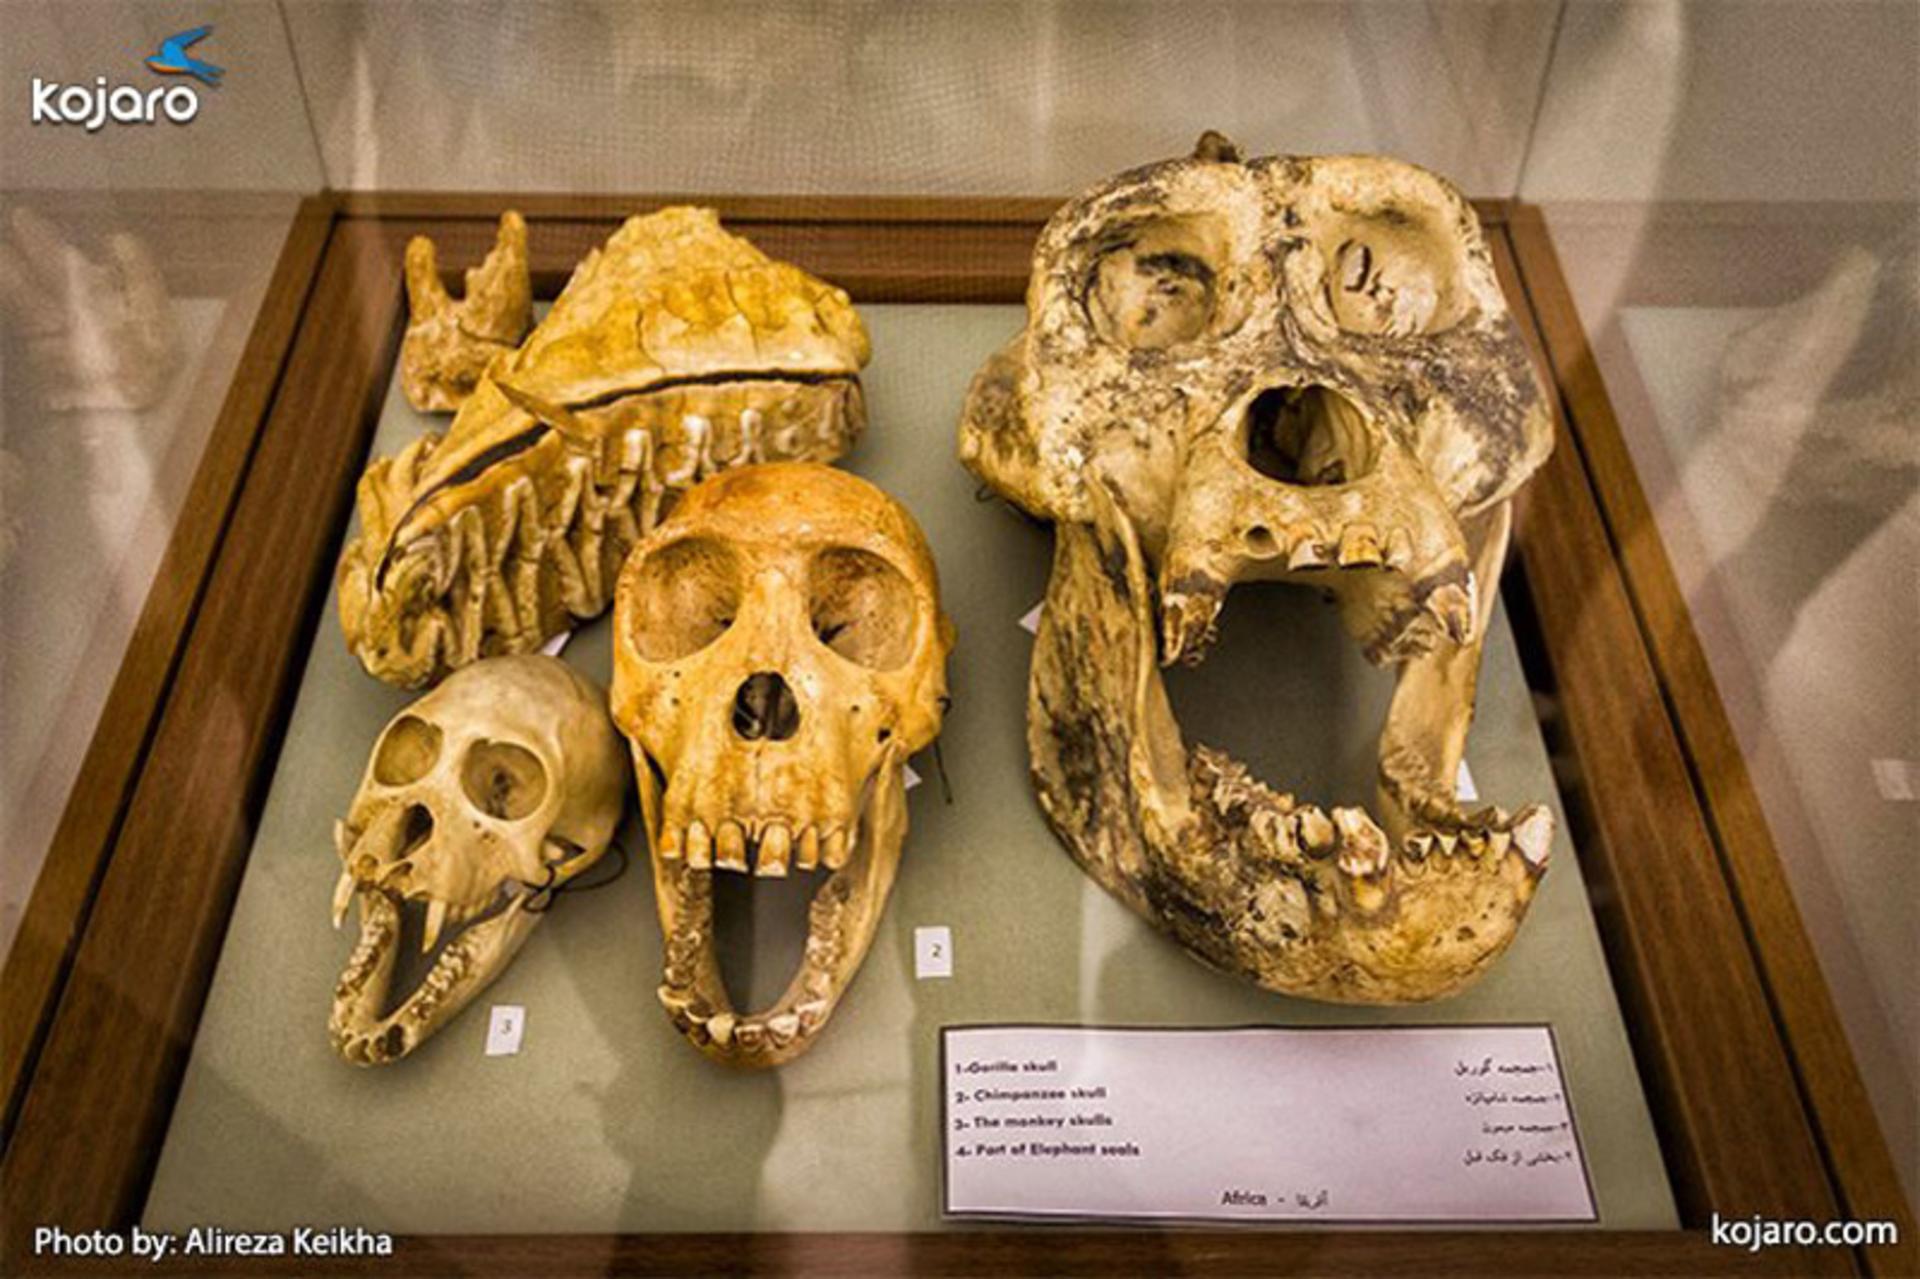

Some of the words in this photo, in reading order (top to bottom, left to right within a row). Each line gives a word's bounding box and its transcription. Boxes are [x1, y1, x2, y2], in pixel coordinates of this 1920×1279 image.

[931, 942, 942, 958] 2
[500, 1018, 513, 1035] 3
[1023, 1060, 1058, 1072] skull
[974, 1089, 1067, 1103] Chimpanzee
[1071, 1086, 1107, 1099] skull
[974, 1116, 1000, 1129] The
[1004, 1115, 1066, 1129] monkey
[1069, 1114, 1113, 1127] skulls
[976, 1144, 1006, 1156] Part
[1010, 1143, 1026, 1155] of
[1030, 1142, 1096, 1157] Elephant
[1221, 1189, 1268, 1206] Africa
